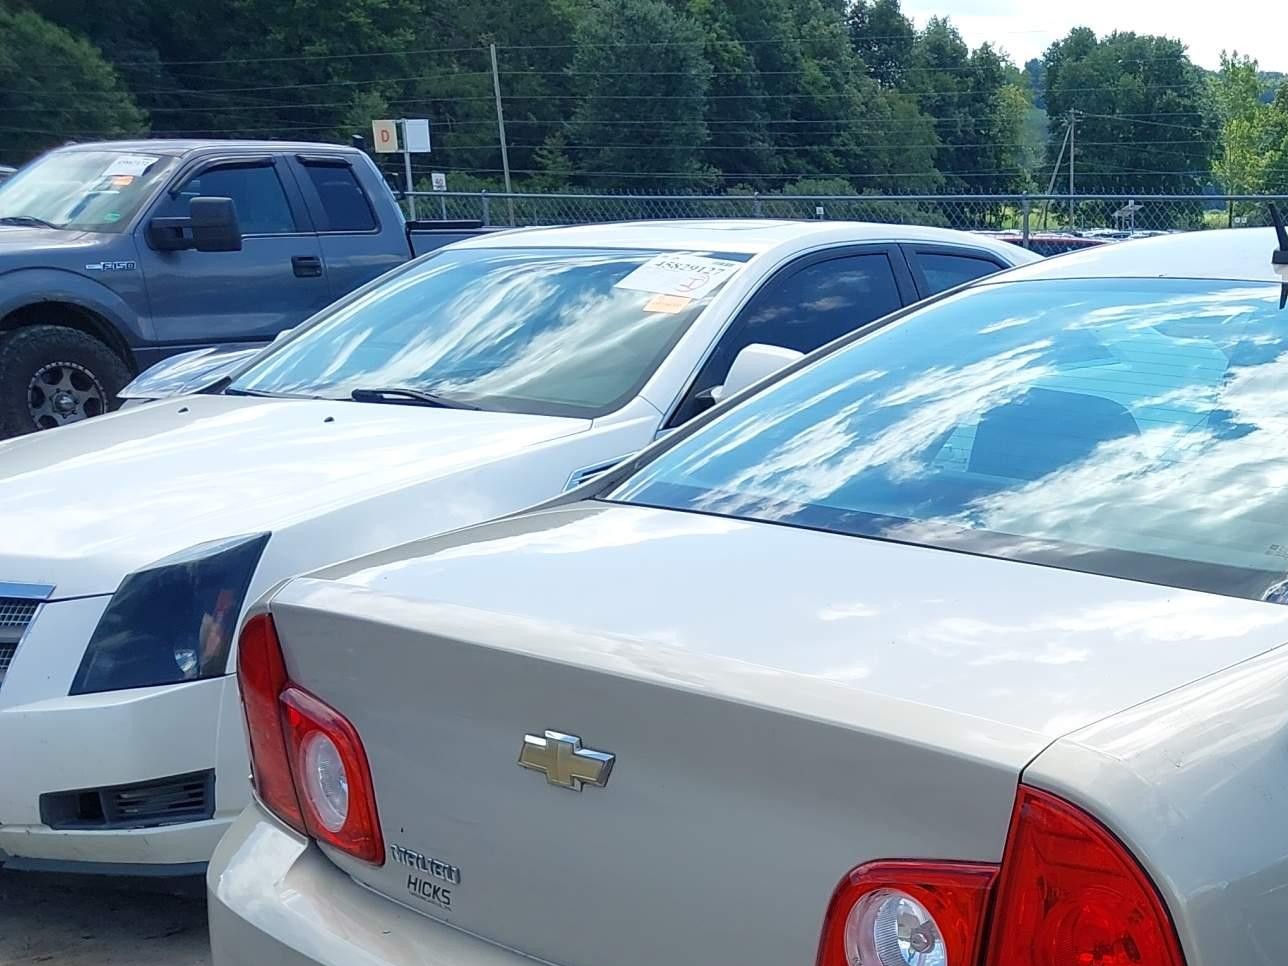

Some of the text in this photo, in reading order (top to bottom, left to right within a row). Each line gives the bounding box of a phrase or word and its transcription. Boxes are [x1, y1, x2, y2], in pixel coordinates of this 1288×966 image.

[380, 129, 390, 143] D
[391, 844, 461, 885] MALIBU
[407, 874, 451, 905] HICKS
